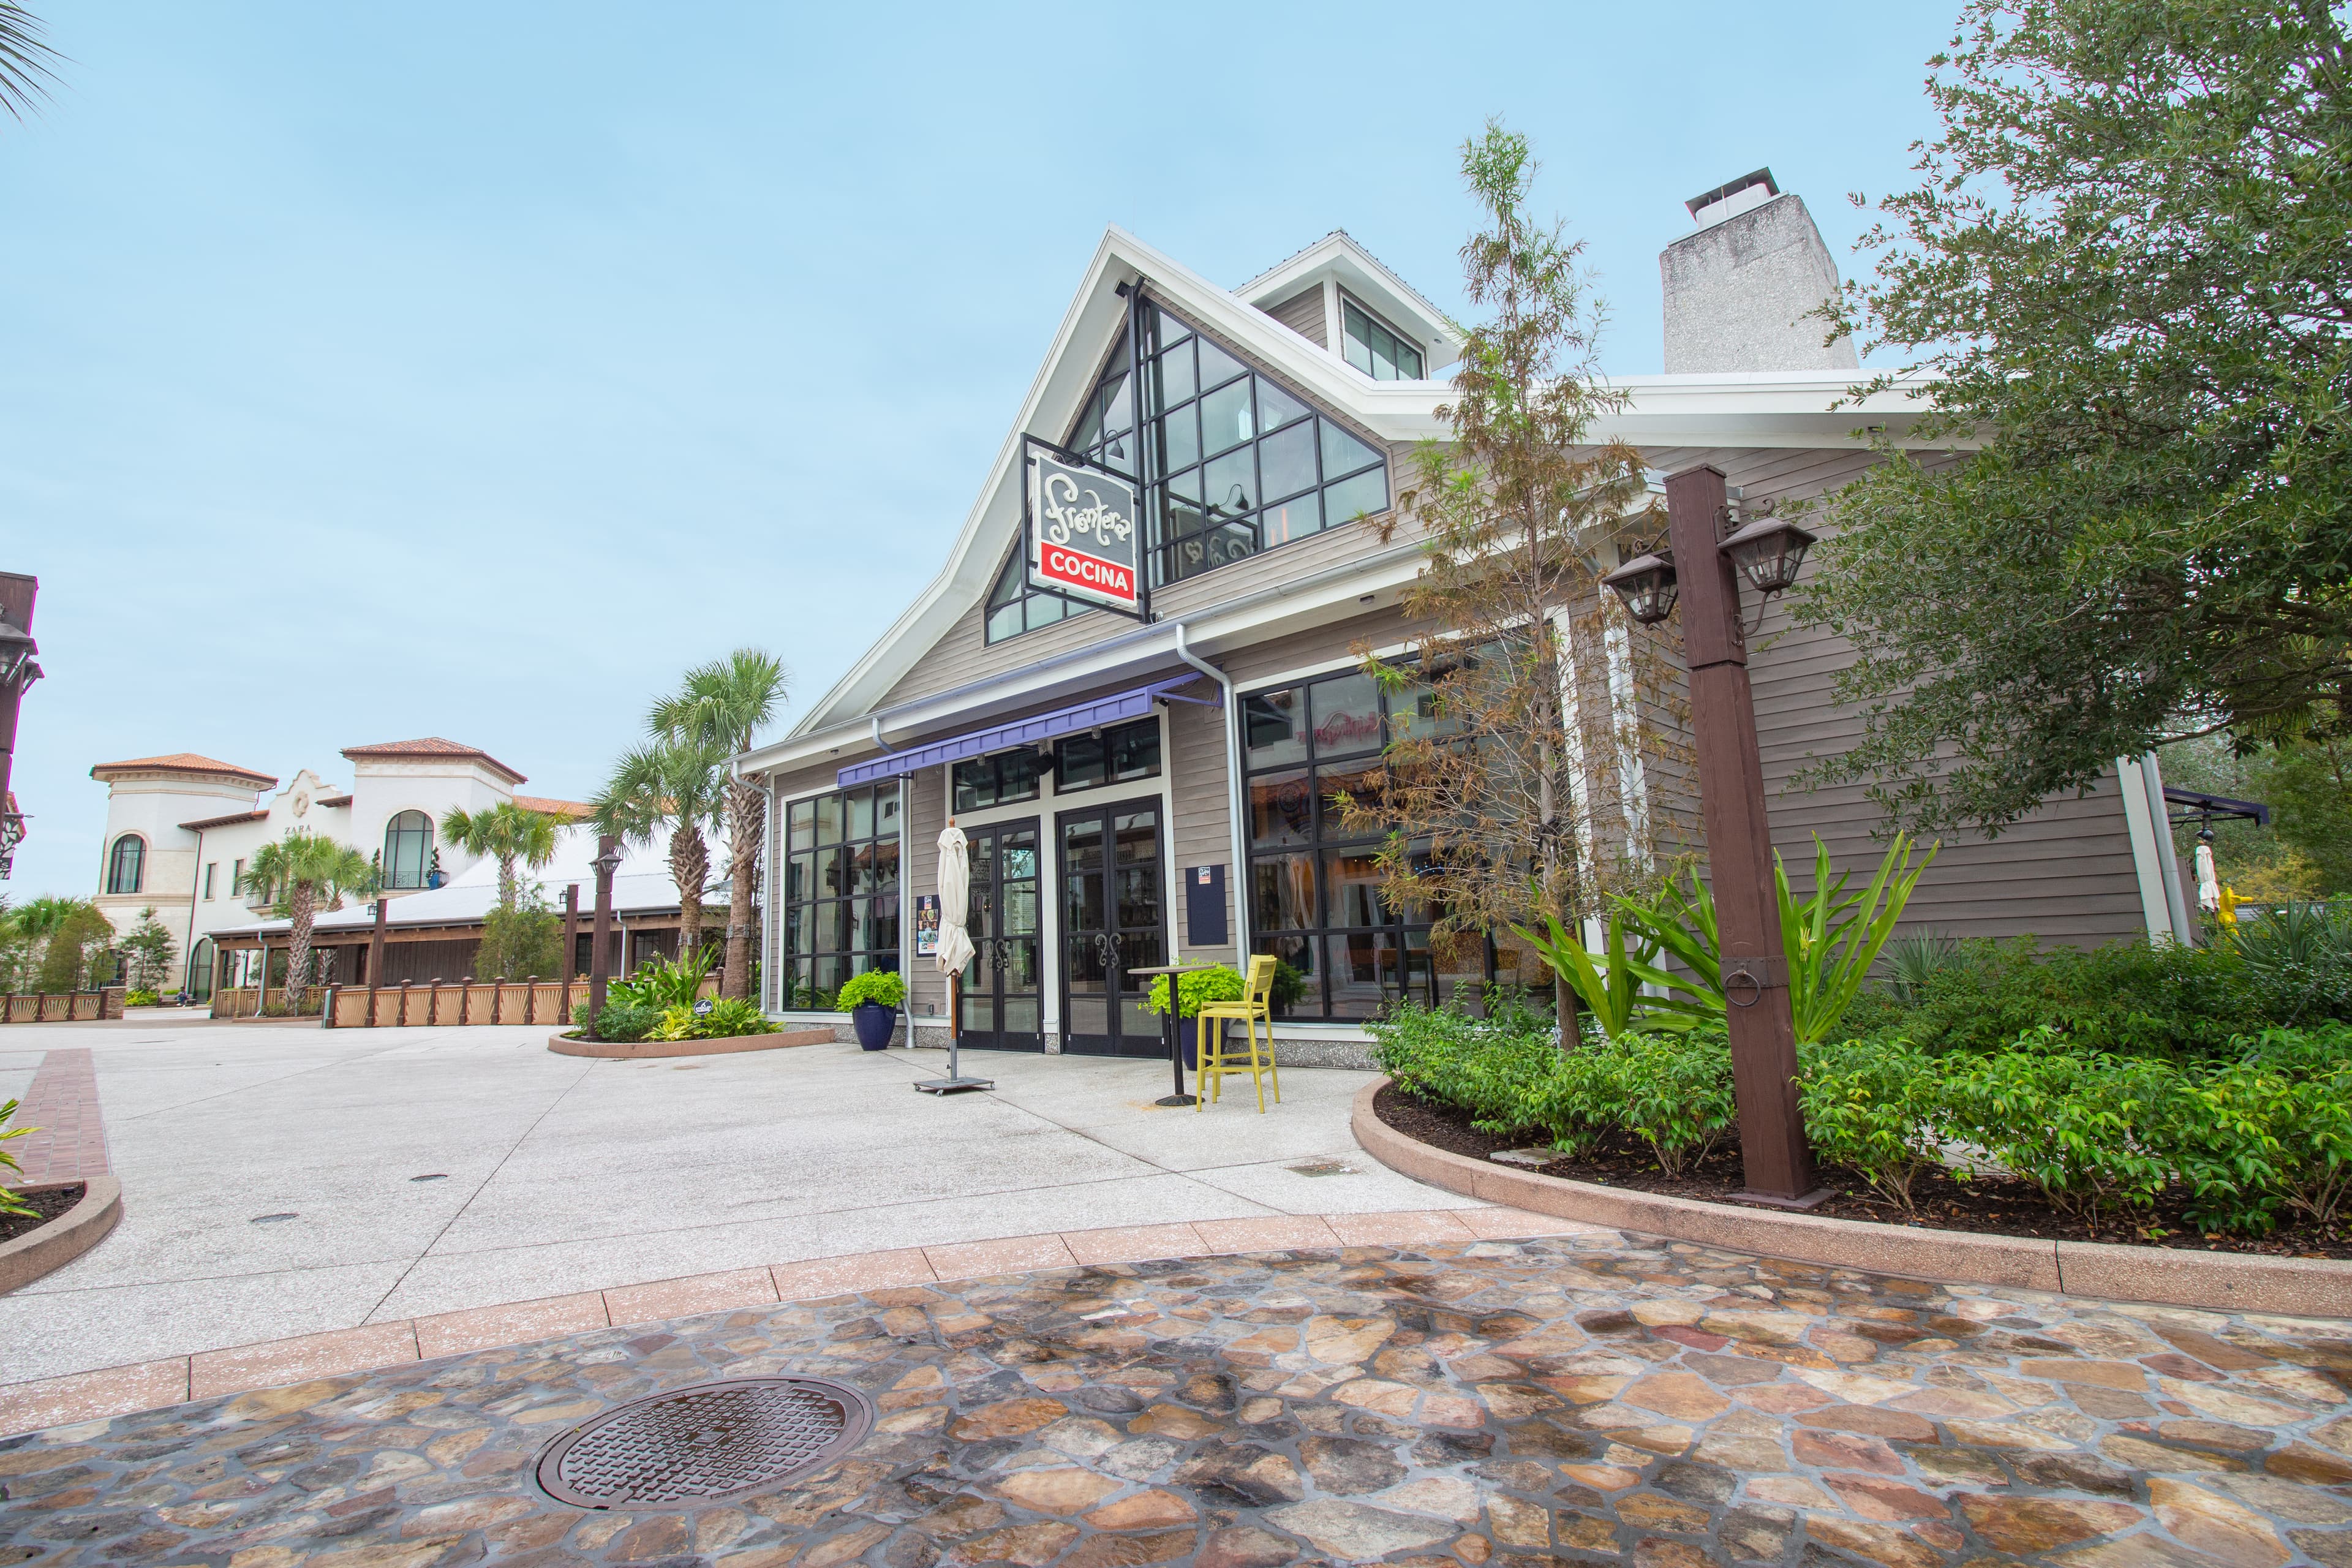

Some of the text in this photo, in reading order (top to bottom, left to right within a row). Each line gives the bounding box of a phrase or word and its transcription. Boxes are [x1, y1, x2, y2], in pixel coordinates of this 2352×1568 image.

[1044, 472, 1131, 546] Frontera
[1050, 551, 1129, 592] COCINA
[285, 824, 312, 835] ZARA
